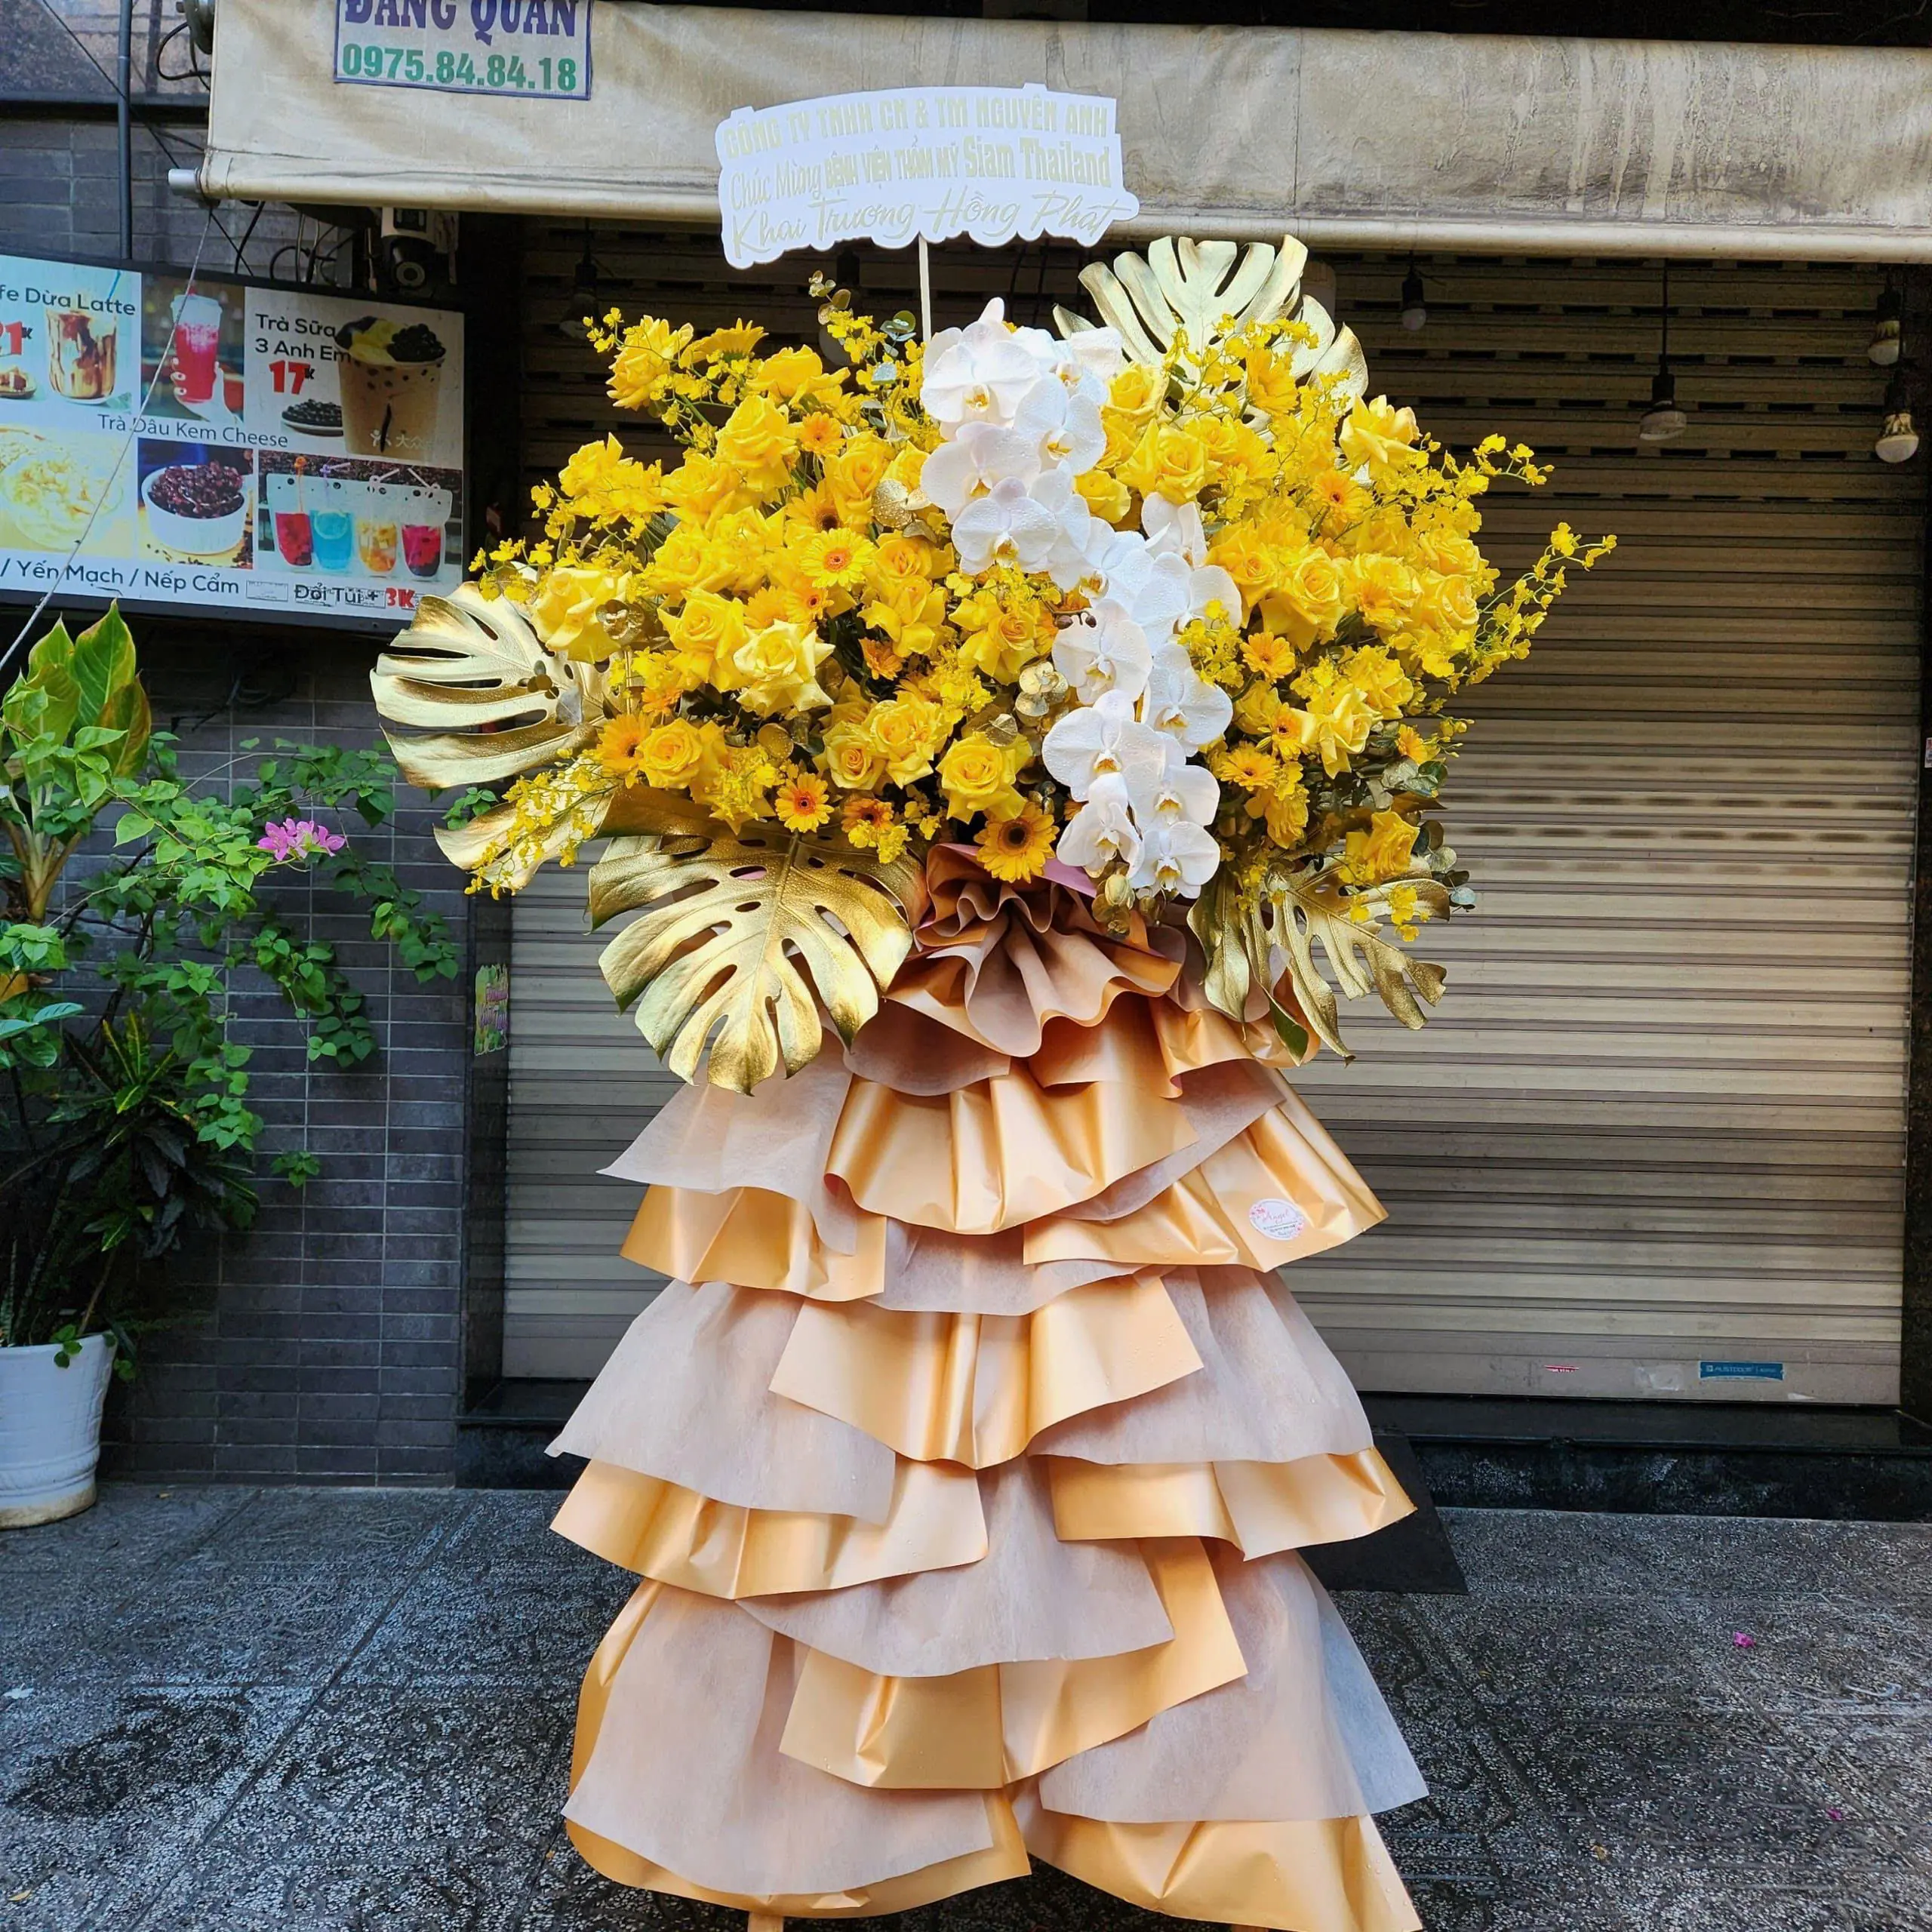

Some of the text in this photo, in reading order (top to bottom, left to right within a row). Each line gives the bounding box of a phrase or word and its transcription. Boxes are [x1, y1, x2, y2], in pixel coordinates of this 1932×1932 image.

[342, 43, 577, 91] 0975.84.84.18
[723, 120, 783, 159] CÔNG
[787, 110, 811, 143] TY
[817, 102, 874, 138] TNHH
[915, 97, 929, 128] &
[935, 95, 968, 128] TM
[1065, 103, 1108, 137] ANH
[731, 168, 771, 211] Chúc
[963, 134, 1017, 179] Siam
[1019, 137, 1112, 188] Thailand
[732, 210, 808, 259] Khai
[26, 288, 71, 307] Dừa
[78, 294, 137, 315] Latte
[255, 313, 336, 337] Trà Sữa
[255, 337, 351, 362] 3 Anh Em
[97, 414, 126, 432] Trà
[177, 423, 217, 441] Kem
[223, 427, 288, 448] Cheese
[17, 560, 59, 580] Yến
[66, 564, 124, 587] Mạch
[145, 570, 187, 592] Nếp
[192, 572, 239, 593] Cẩm
